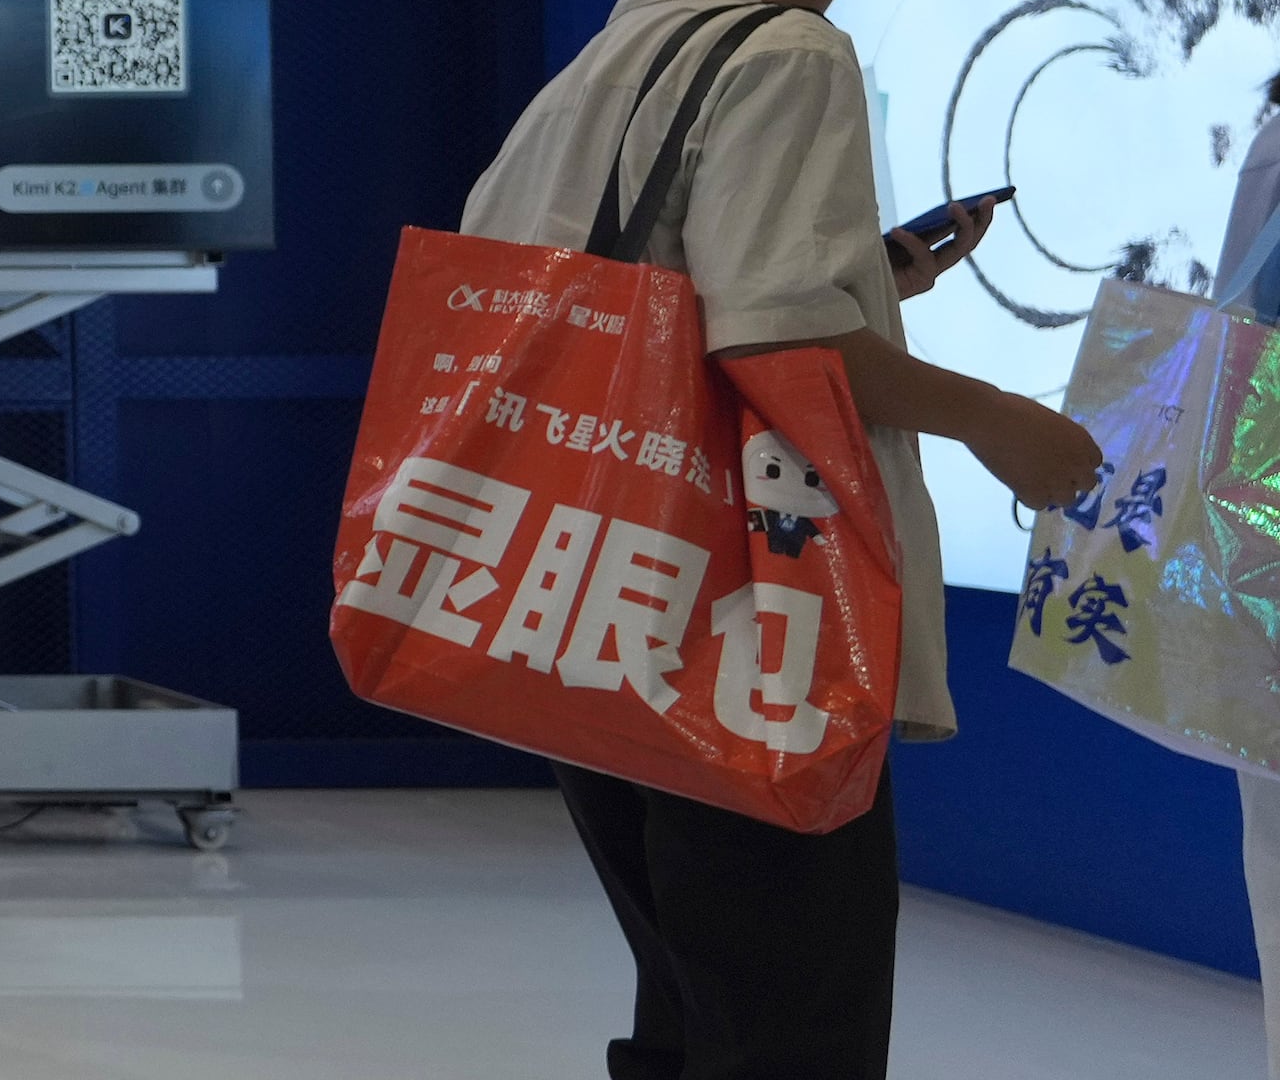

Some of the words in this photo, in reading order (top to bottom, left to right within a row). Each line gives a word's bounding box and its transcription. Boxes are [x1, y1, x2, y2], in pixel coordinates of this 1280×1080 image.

[12, 180, 50, 197] Kimi
[96, 180, 147, 199] Agent
[152, 177, 187, 198] 集群
[336, 456, 829, 756] 显眼包
